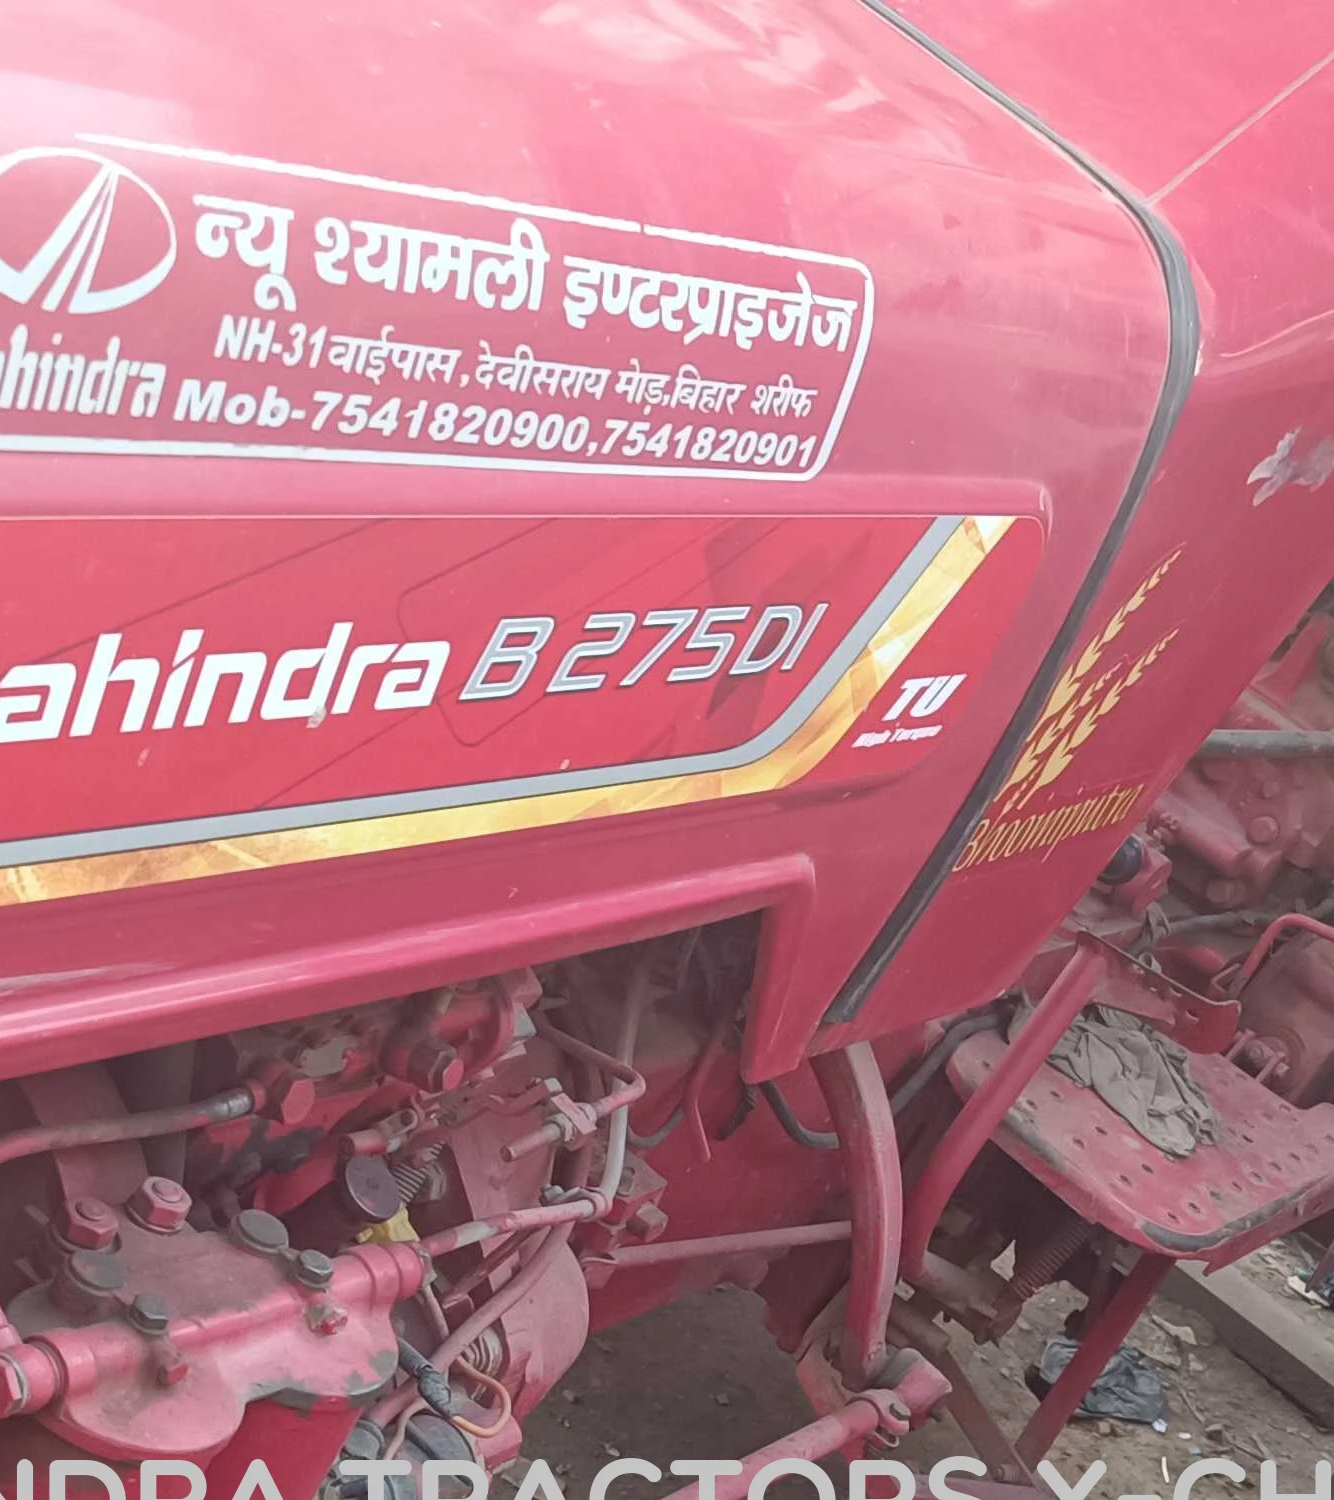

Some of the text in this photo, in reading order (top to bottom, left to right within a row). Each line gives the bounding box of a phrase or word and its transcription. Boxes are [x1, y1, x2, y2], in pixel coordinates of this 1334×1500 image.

[192, 193, 297, 312] न्यू
[313, 215, 551, 312] श्यामली
[750, 374, 818, 418] शरीफ
[458, 616, 556, 702] B
[545, 603, 829, 694] 275DI
[881, 673, 968, 722] TU
